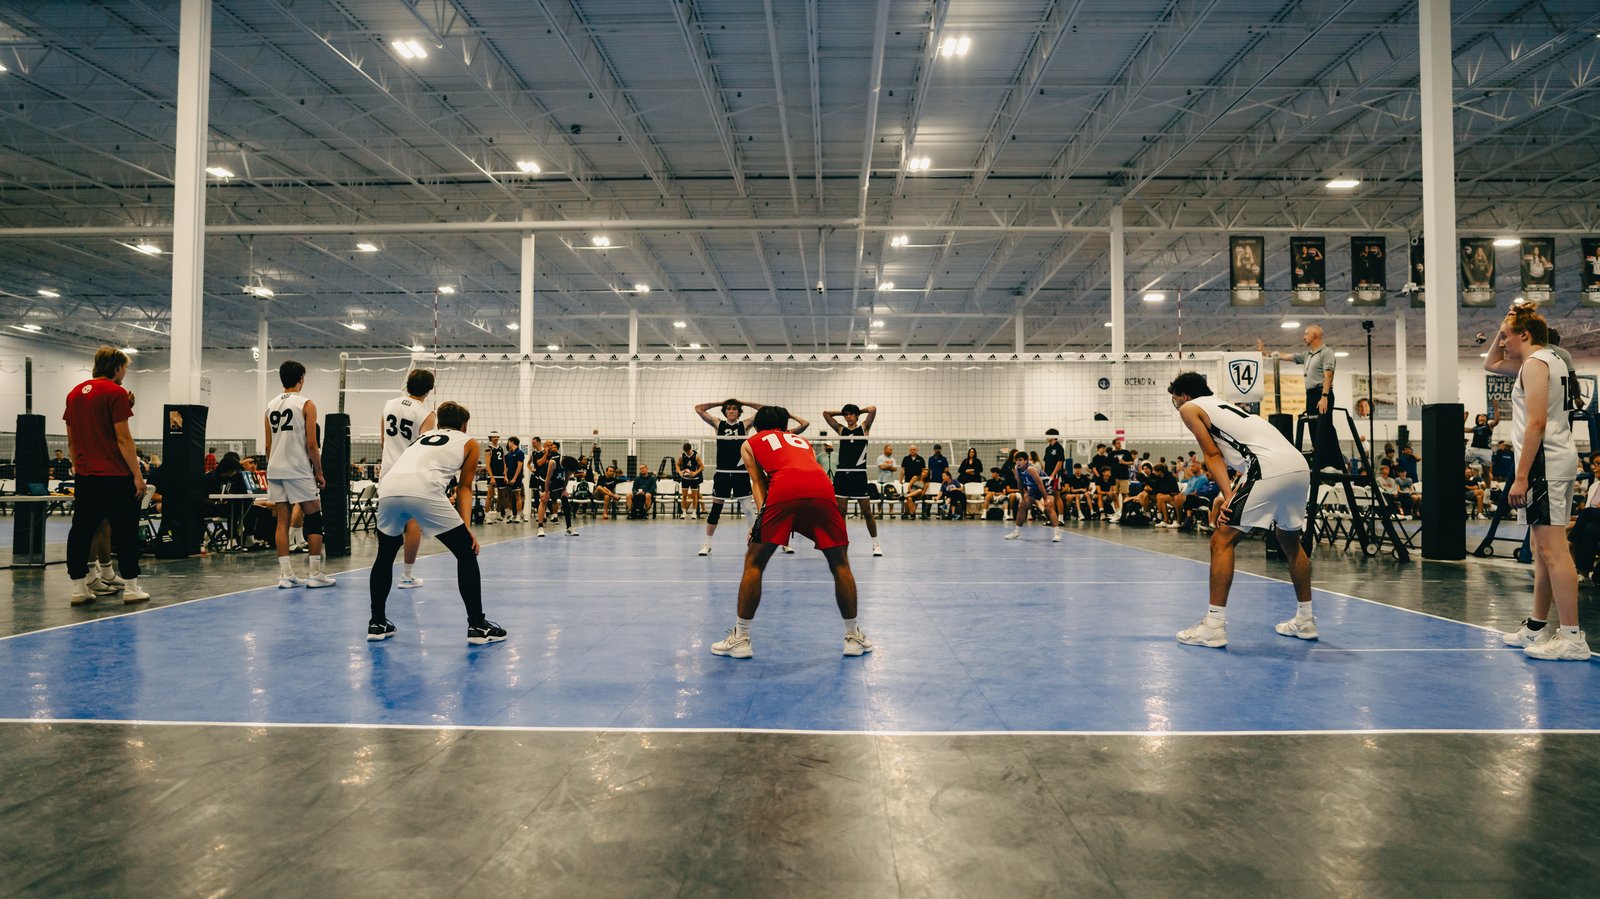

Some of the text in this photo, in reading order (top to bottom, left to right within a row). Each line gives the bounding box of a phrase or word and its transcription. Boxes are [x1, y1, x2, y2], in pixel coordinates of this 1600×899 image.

[1233, 364, 1253, 386] 14
[269, 408, 293, 433] 92
[386, 413, 414, 441] 35
[761, 433, 810, 451] 16
[496, 451, 502, 460] 2
[244, 473, 256, 489] 15
